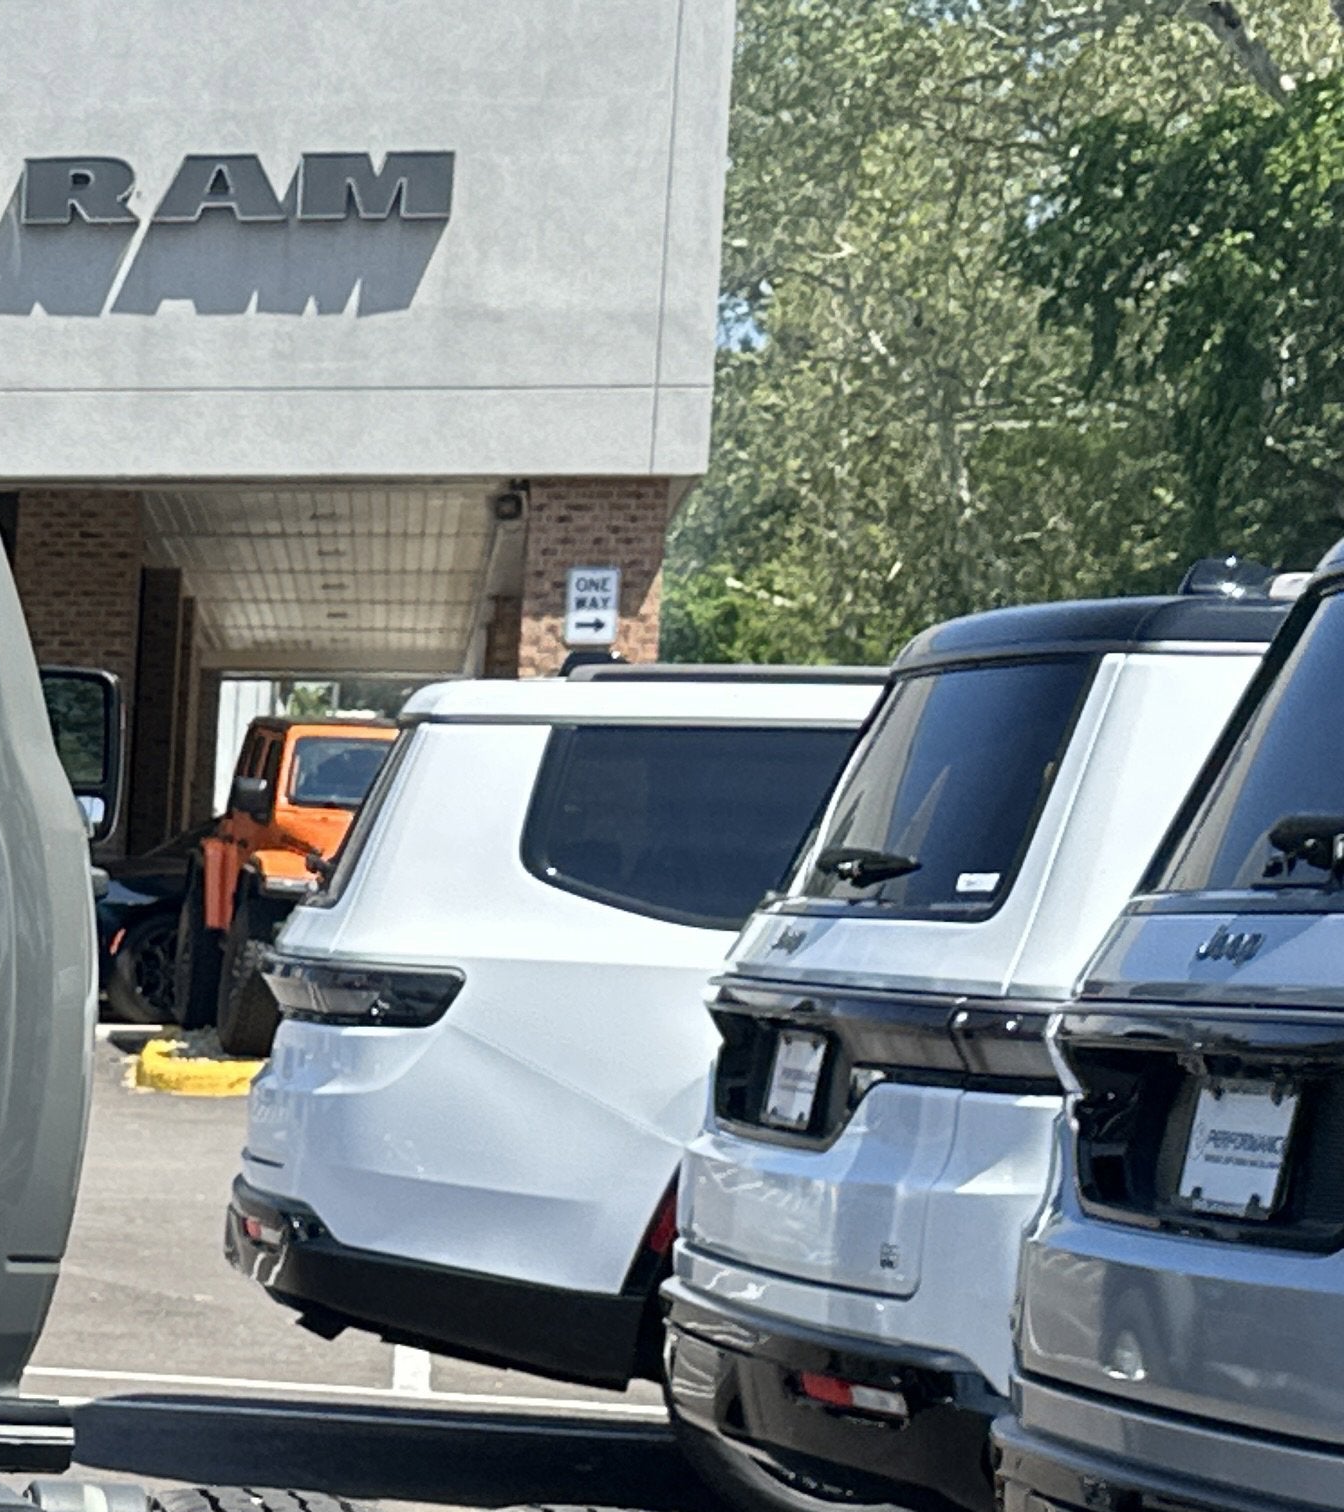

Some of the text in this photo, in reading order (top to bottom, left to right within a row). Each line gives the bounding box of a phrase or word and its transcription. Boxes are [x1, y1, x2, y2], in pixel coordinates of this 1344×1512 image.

[21, 151, 456, 226] RAM
[575, 577, 611, 592] ONE
[575, 597, 611, 610] WAY
